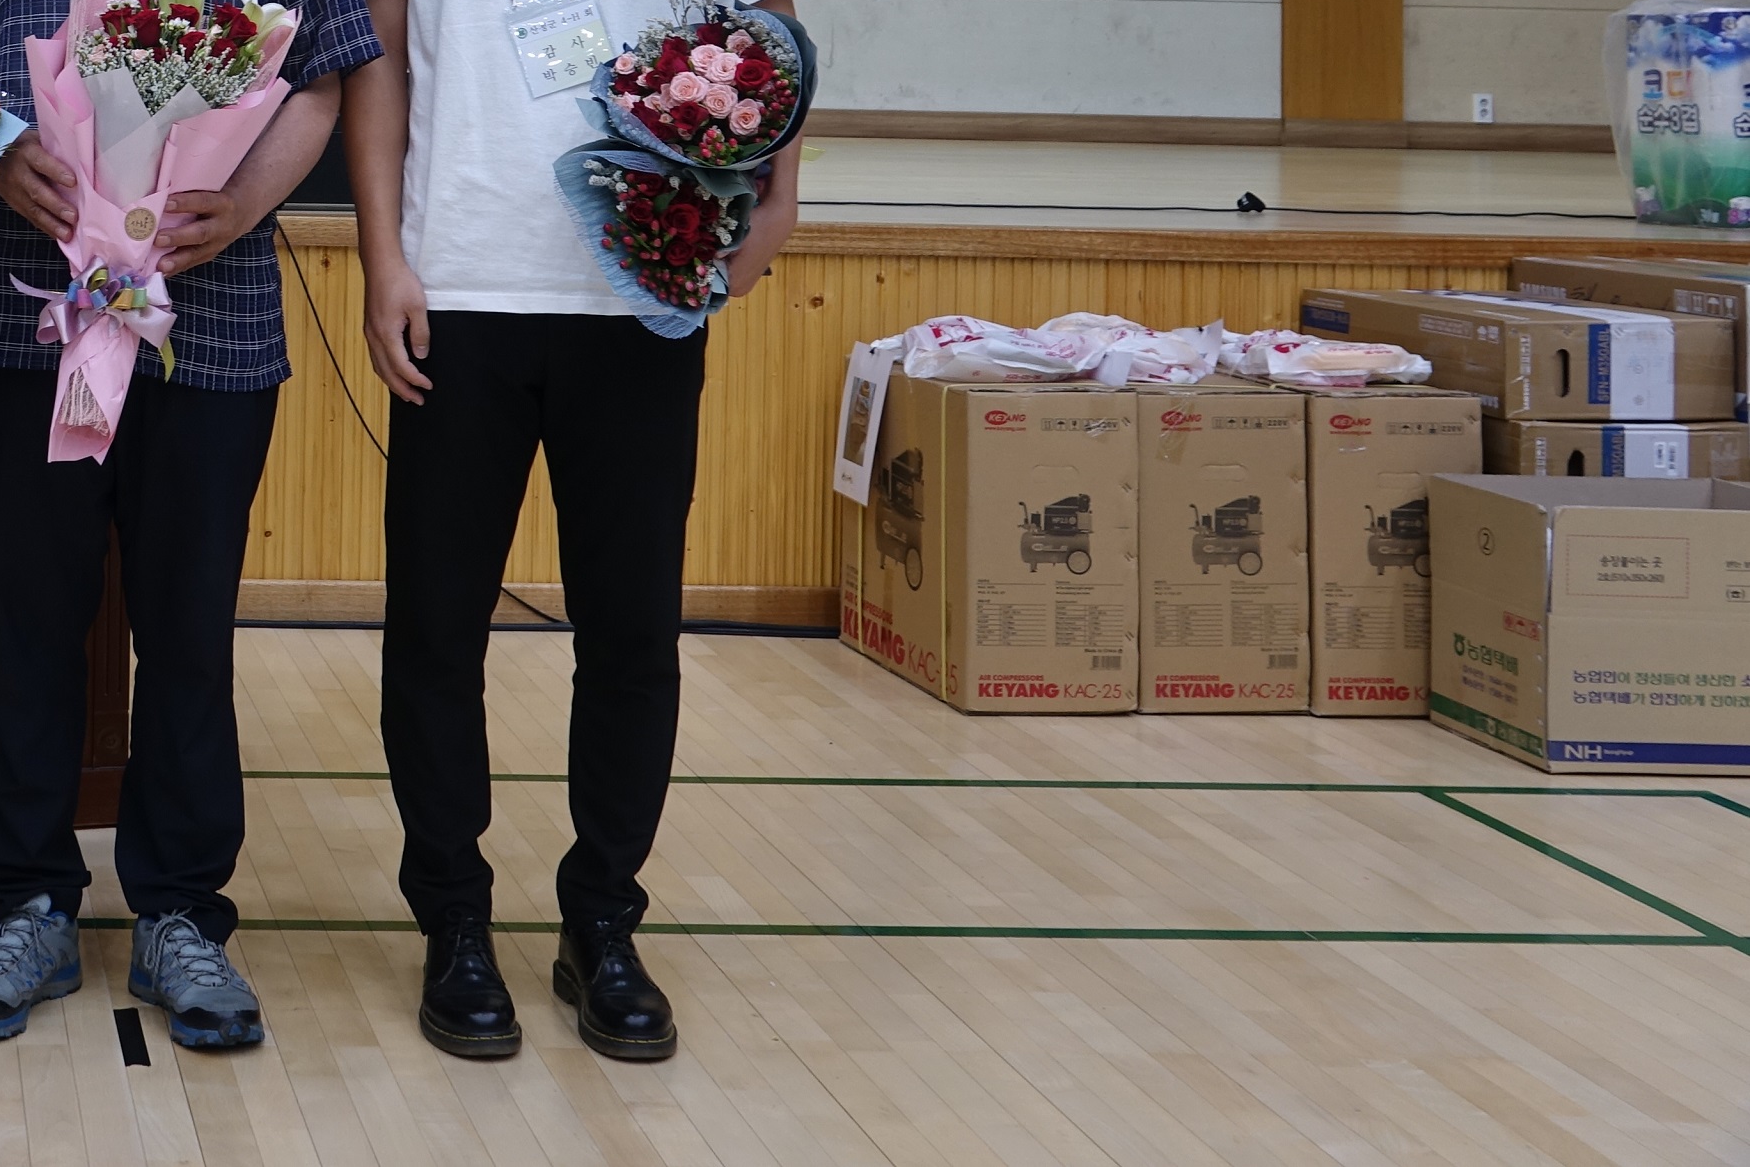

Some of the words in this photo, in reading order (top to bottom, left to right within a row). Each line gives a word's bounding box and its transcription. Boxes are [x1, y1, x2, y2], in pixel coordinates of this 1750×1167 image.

[1642, 68, 1693, 100] 코디
[1636, 103, 1700, 134] 순수3겹
[985, 410, 1027, 425] KEYANG
[908, 641, 958, 694] KAC-5
[1573, 670, 1631, 684] 농업인이
[978, 683, 1059, 698] KEYANG
[1064, 684, 1122, 698] KAC-25
[1155, 683, 1235, 698] KEYANG
[1239, 684, 1295, 699] KAC-25
[1328, 686, 1410, 701] KEYANG
[1573, 691, 1645, 705] 농협택배가
[1564, 744, 1602, 760] NH
